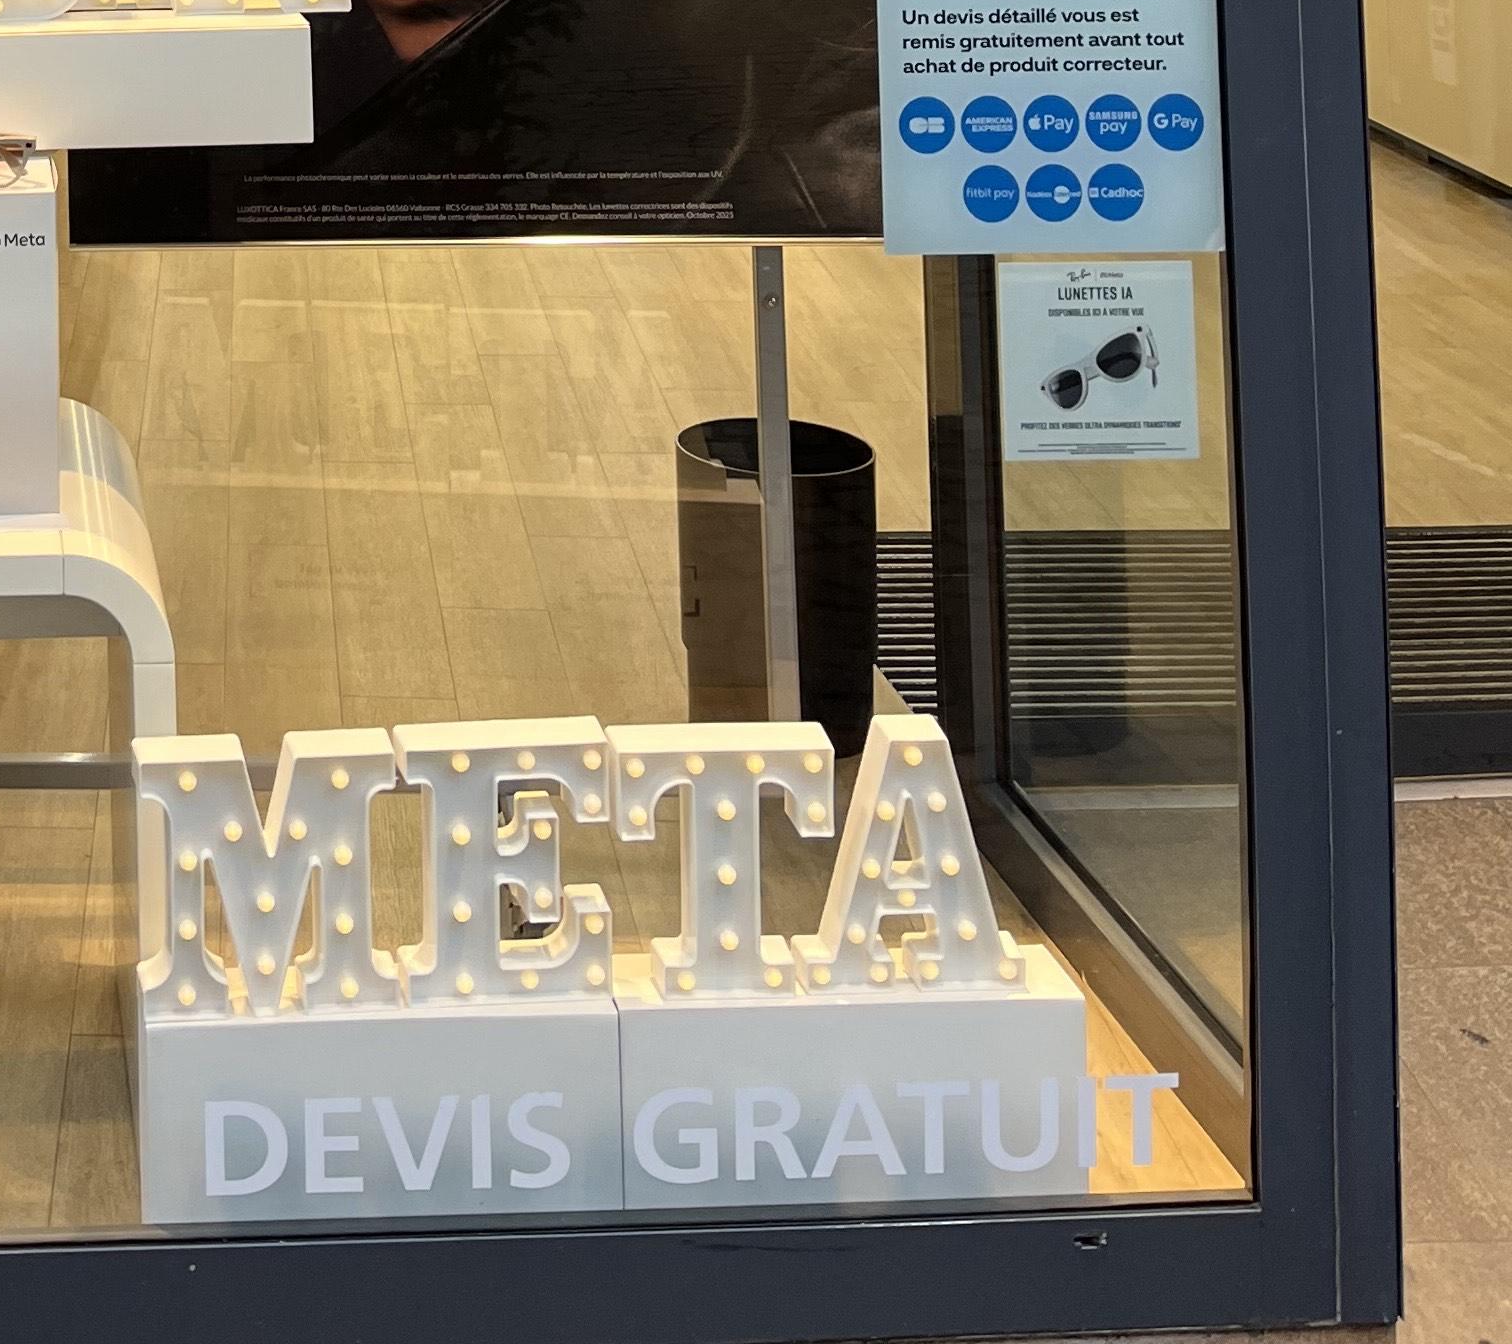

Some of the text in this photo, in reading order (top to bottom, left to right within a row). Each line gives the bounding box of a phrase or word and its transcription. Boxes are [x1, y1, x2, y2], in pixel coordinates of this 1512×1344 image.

[902, 7, 1140, 25] Un devis détaillé vous est
[902, 32, 1185, 53] remis gratuitement avant tout
[903, 56, 1168, 77] achat de produit correcteur.
[1043, 114, 1074, 134] Pay
[1088, 111, 1138, 120] SAMSUNG
[1153, 113, 1198, 132] G Pay
[1099, 121, 1128, 135] pay
[966, 187, 992, 199] fitbit
[993, 189, 1015, 200] pay
[1100, 187, 1144, 199] Cadhoc
[4, 231, 47, 248] Meta
[1057, 286, 1133, 301] LUNETTES IA
[131, 712, 1031, 1019] META
[203, 1072, 1180, 1199] DEVIS GRATUIT
